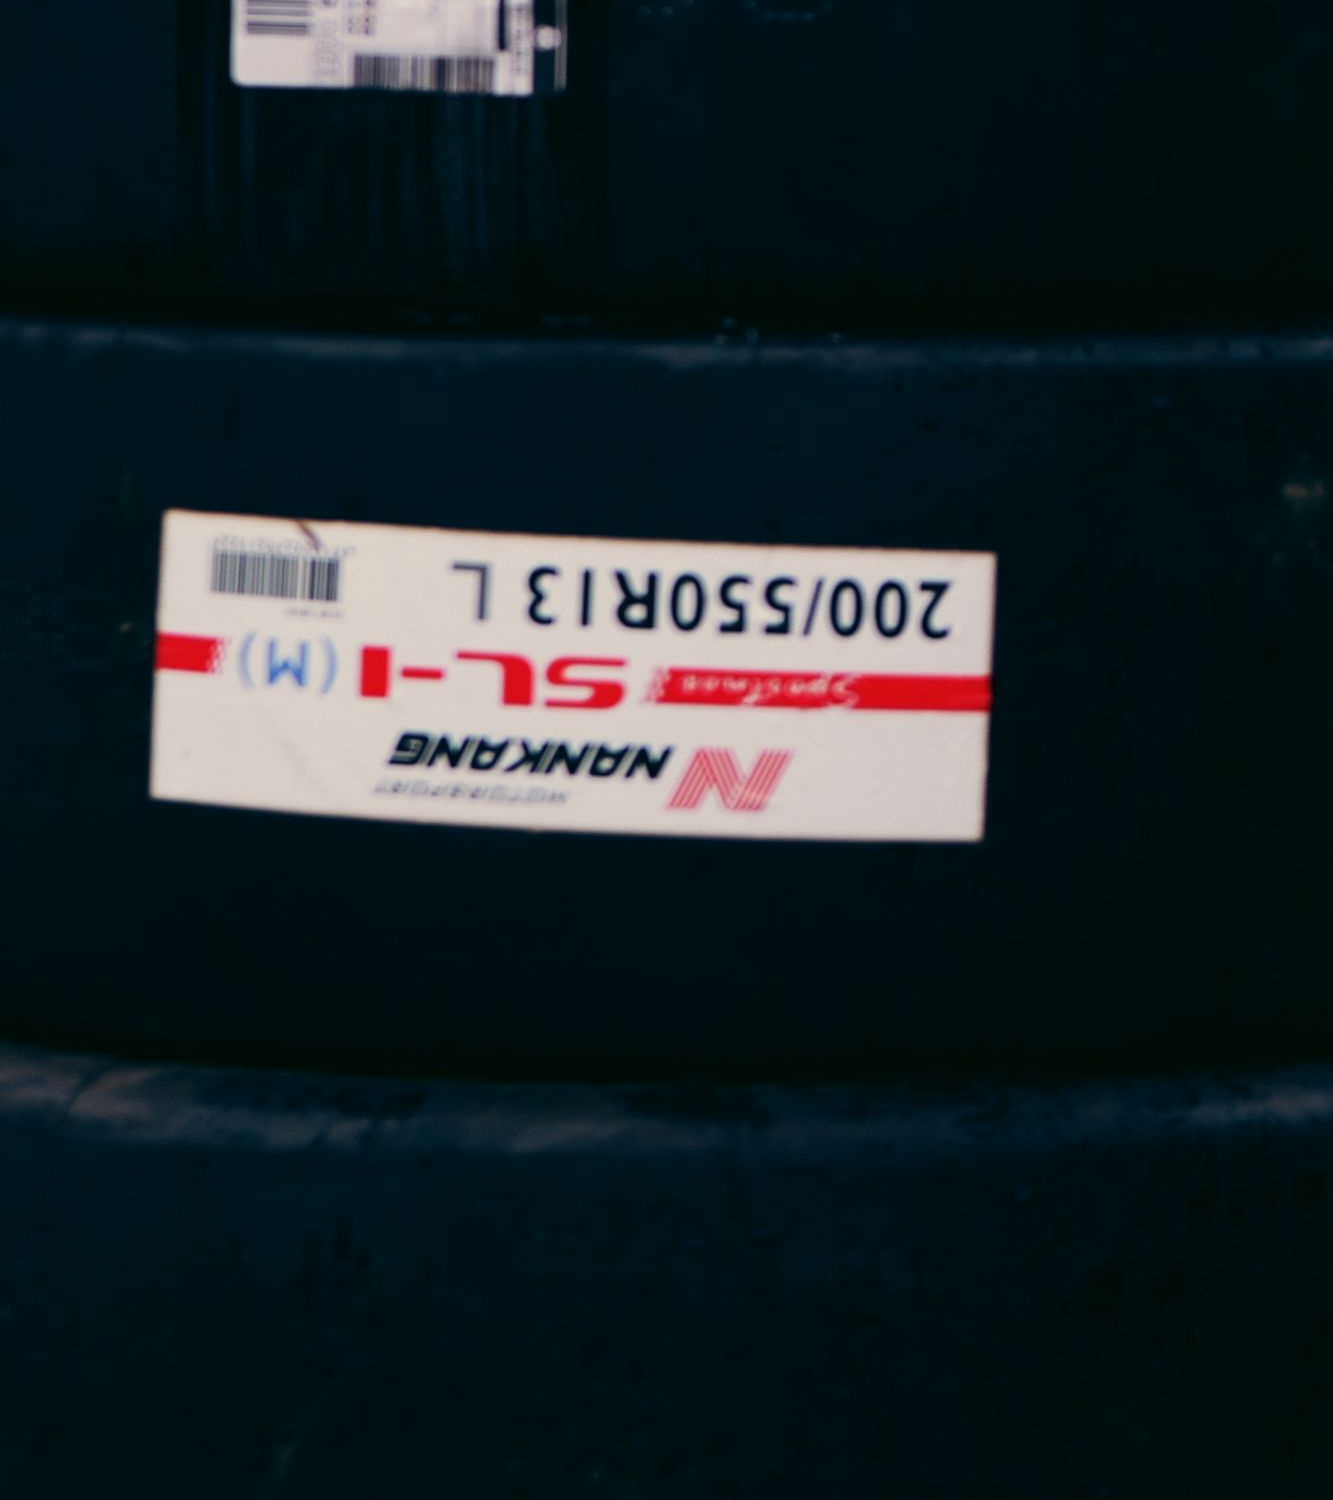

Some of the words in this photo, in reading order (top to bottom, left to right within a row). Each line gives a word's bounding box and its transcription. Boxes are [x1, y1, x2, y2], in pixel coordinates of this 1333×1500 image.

[526, 562, 952, 641] 200/550R13
[235, 631, 340, 695] (M)
[386, 729, 675, 784] NANKANG
[368, 778, 569, 806] MOTORSPORT
